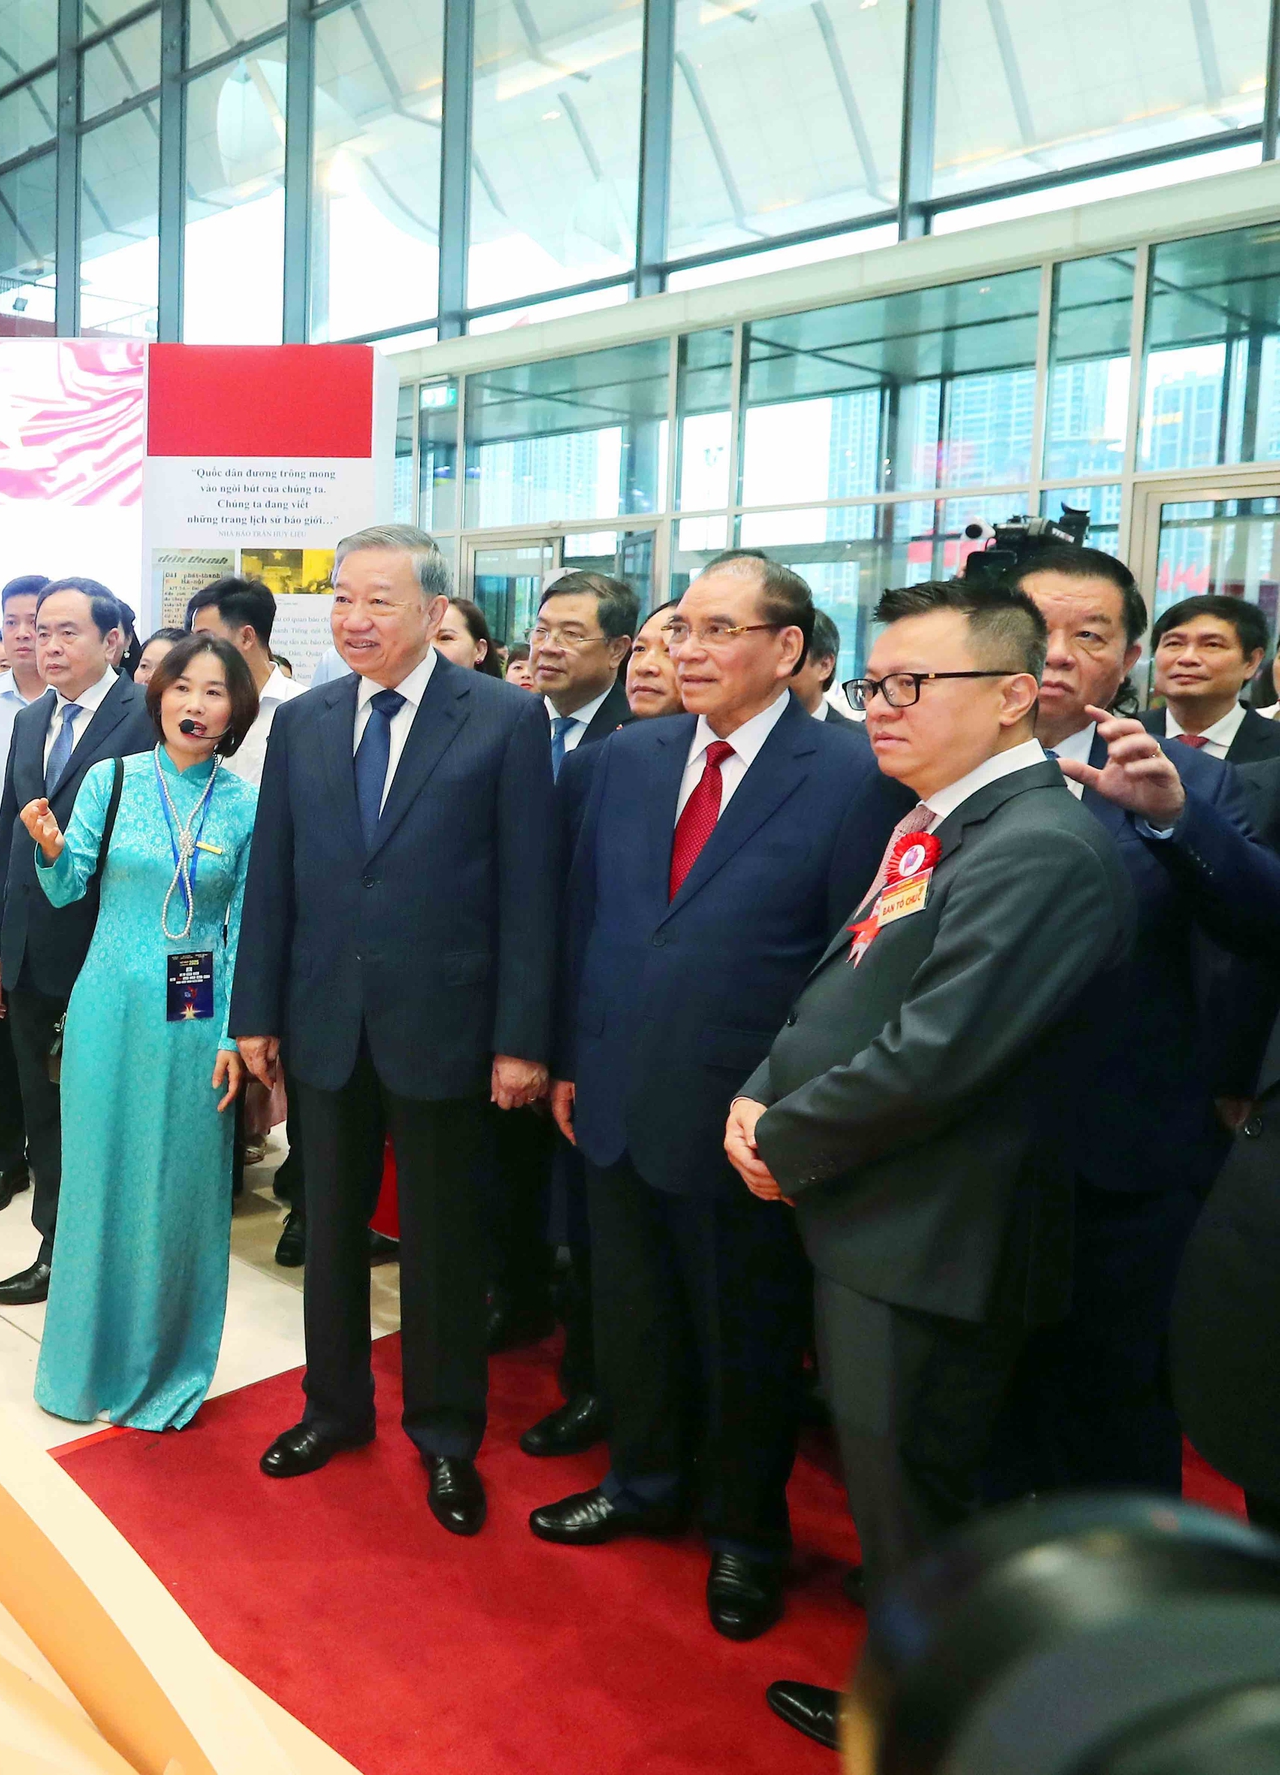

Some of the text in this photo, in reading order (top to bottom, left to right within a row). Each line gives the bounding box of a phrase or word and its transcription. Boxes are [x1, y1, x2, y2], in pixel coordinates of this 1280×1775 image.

[224, 467, 243, 478] dân
[308, 469, 336, 480] mong
[200, 483, 218, 493] vào
[243, 483, 260, 493] bút
[262, 484, 279, 493] của
[281, 484, 312, 495] chúng
[217, 498, 250, 510] Chúng
[252, 500, 262, 509] ta
[291, 497, 309, 509] viết
[186, 514, 218, 525] những
[221, 515, 248, 526] trang
[249, 515, 267, 527] lịch
[283, 515, 302, 524] báo
